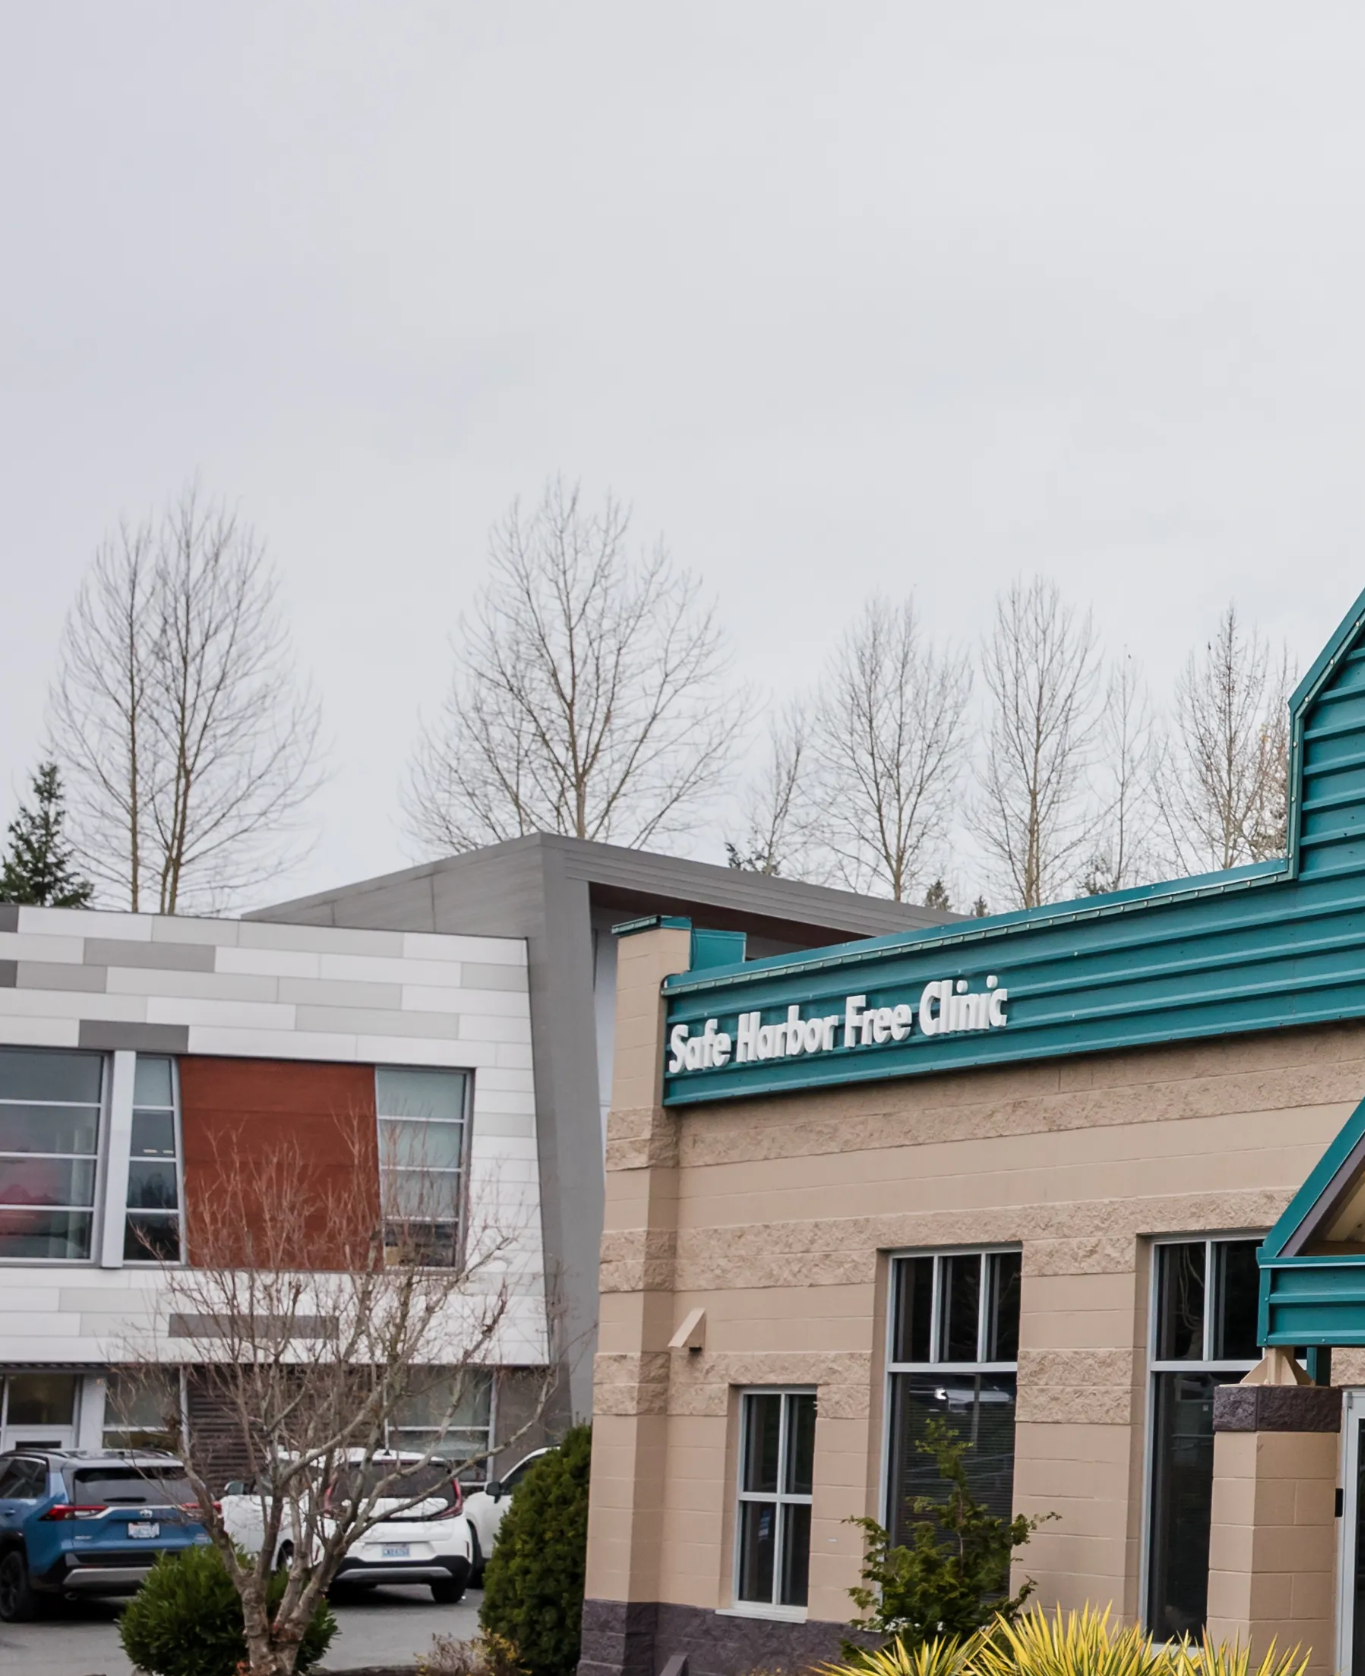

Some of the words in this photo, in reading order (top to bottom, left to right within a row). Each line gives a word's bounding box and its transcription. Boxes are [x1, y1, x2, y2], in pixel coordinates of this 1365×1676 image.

[669, 1019, 731, 1074] Safe
[736, 1005, 838, 1063] Harbor
[844, 995, 912, 1048] Free
[919, 975, 1008, 1036] Clinic
